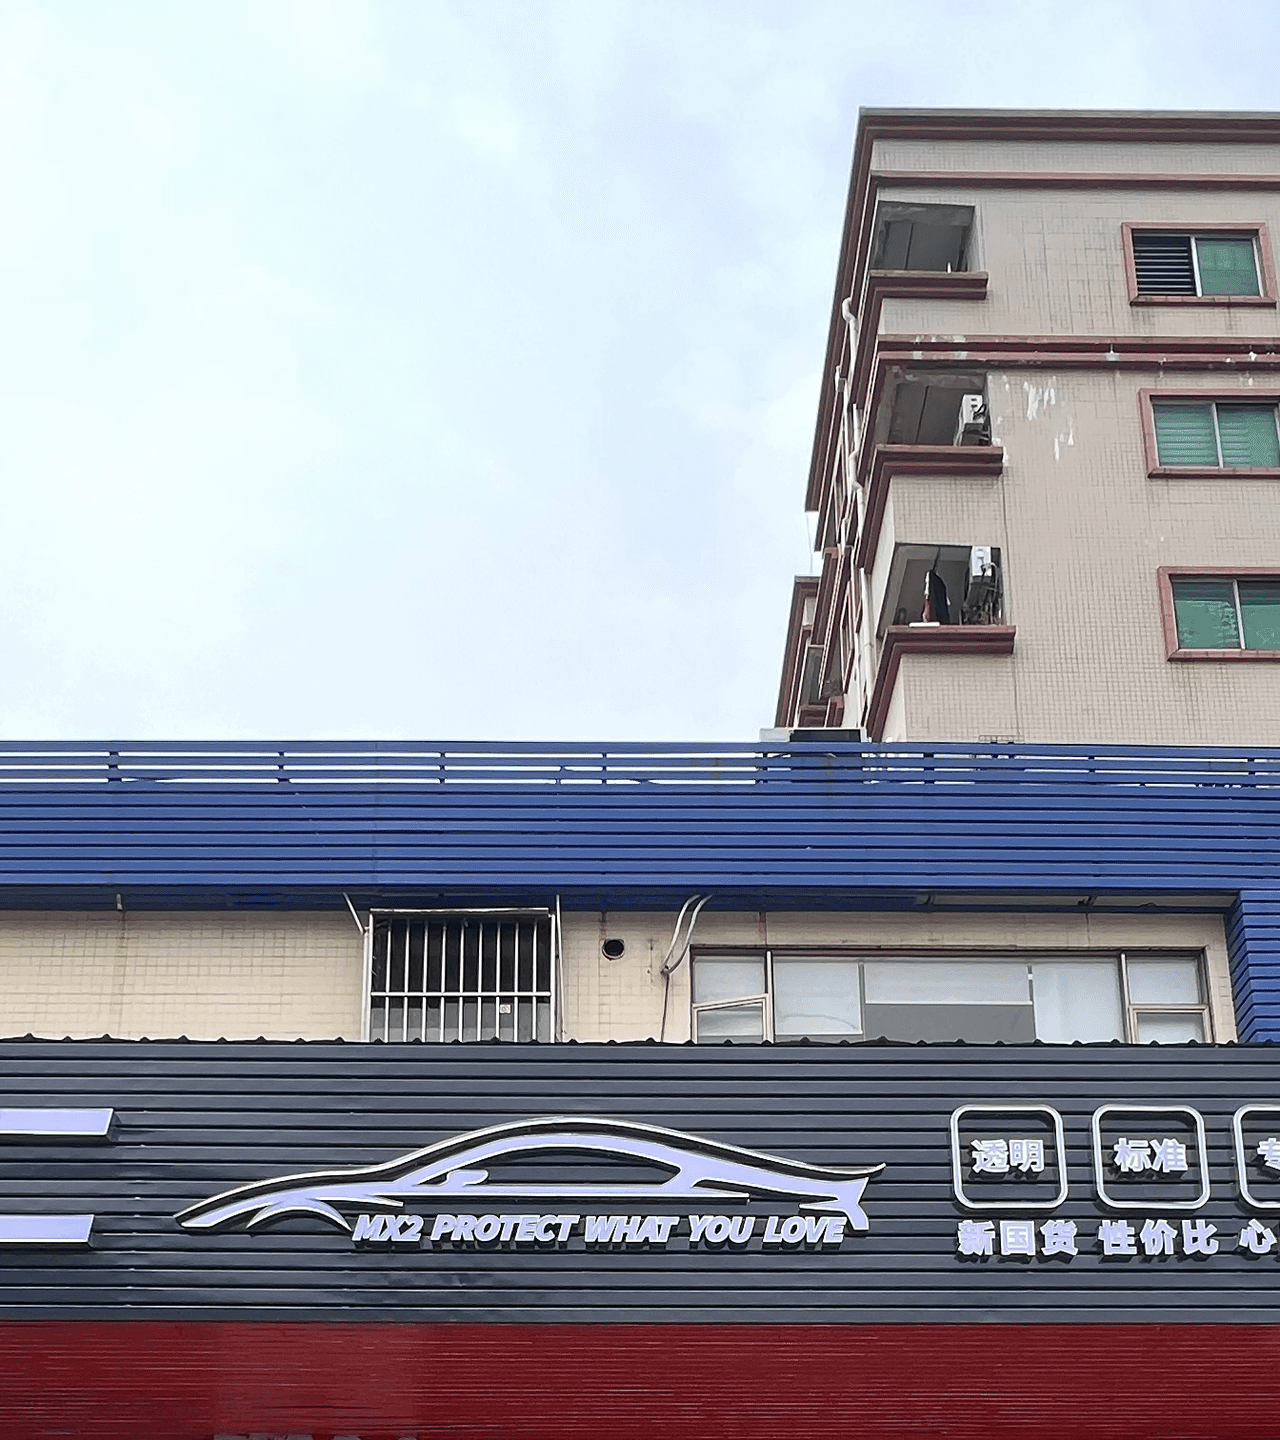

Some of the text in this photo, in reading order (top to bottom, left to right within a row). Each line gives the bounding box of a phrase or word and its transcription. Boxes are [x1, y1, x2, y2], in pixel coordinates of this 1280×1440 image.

[971, 1139, 1045, 1173] 透明
[1113, 1138, 1188, 1173] 标准
[352, 1214, 847, 1244] MX2 PROTECT WHAT YOU LOVE
[957, 1219, 1078, 1256] 新国货
[1098, 1219, 1219, 1256] 性价比
